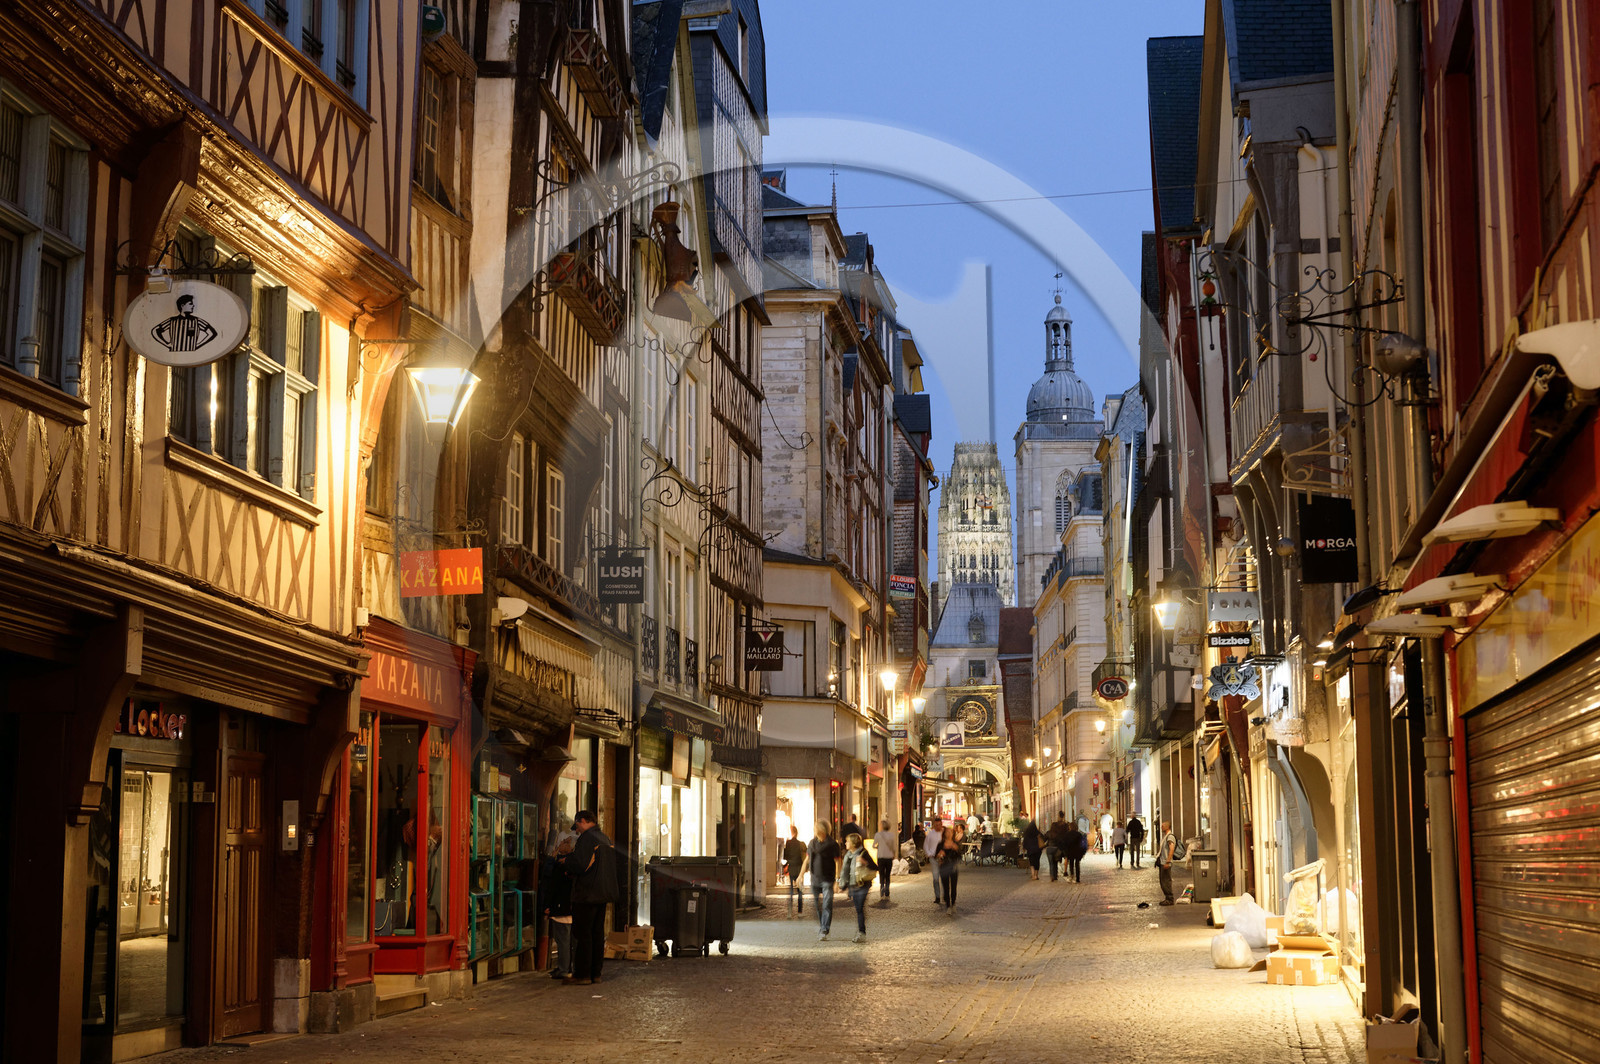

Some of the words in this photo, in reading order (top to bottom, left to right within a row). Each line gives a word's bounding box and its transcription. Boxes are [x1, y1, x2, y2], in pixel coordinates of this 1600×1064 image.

[1305, 538, 1358, 549] MORGA
[400, 566, 483, 588] KAZANA
[600, 566, 642, 578] LUSH
[891, 581, 914, 589] FONCIA
[1211, 636, 1250, 646] Bizzbee
[377, 652, 442, 704] KAZANA
[1102, 683, 1124, 694] C&A
[128, 697, 186, 739] Locker
